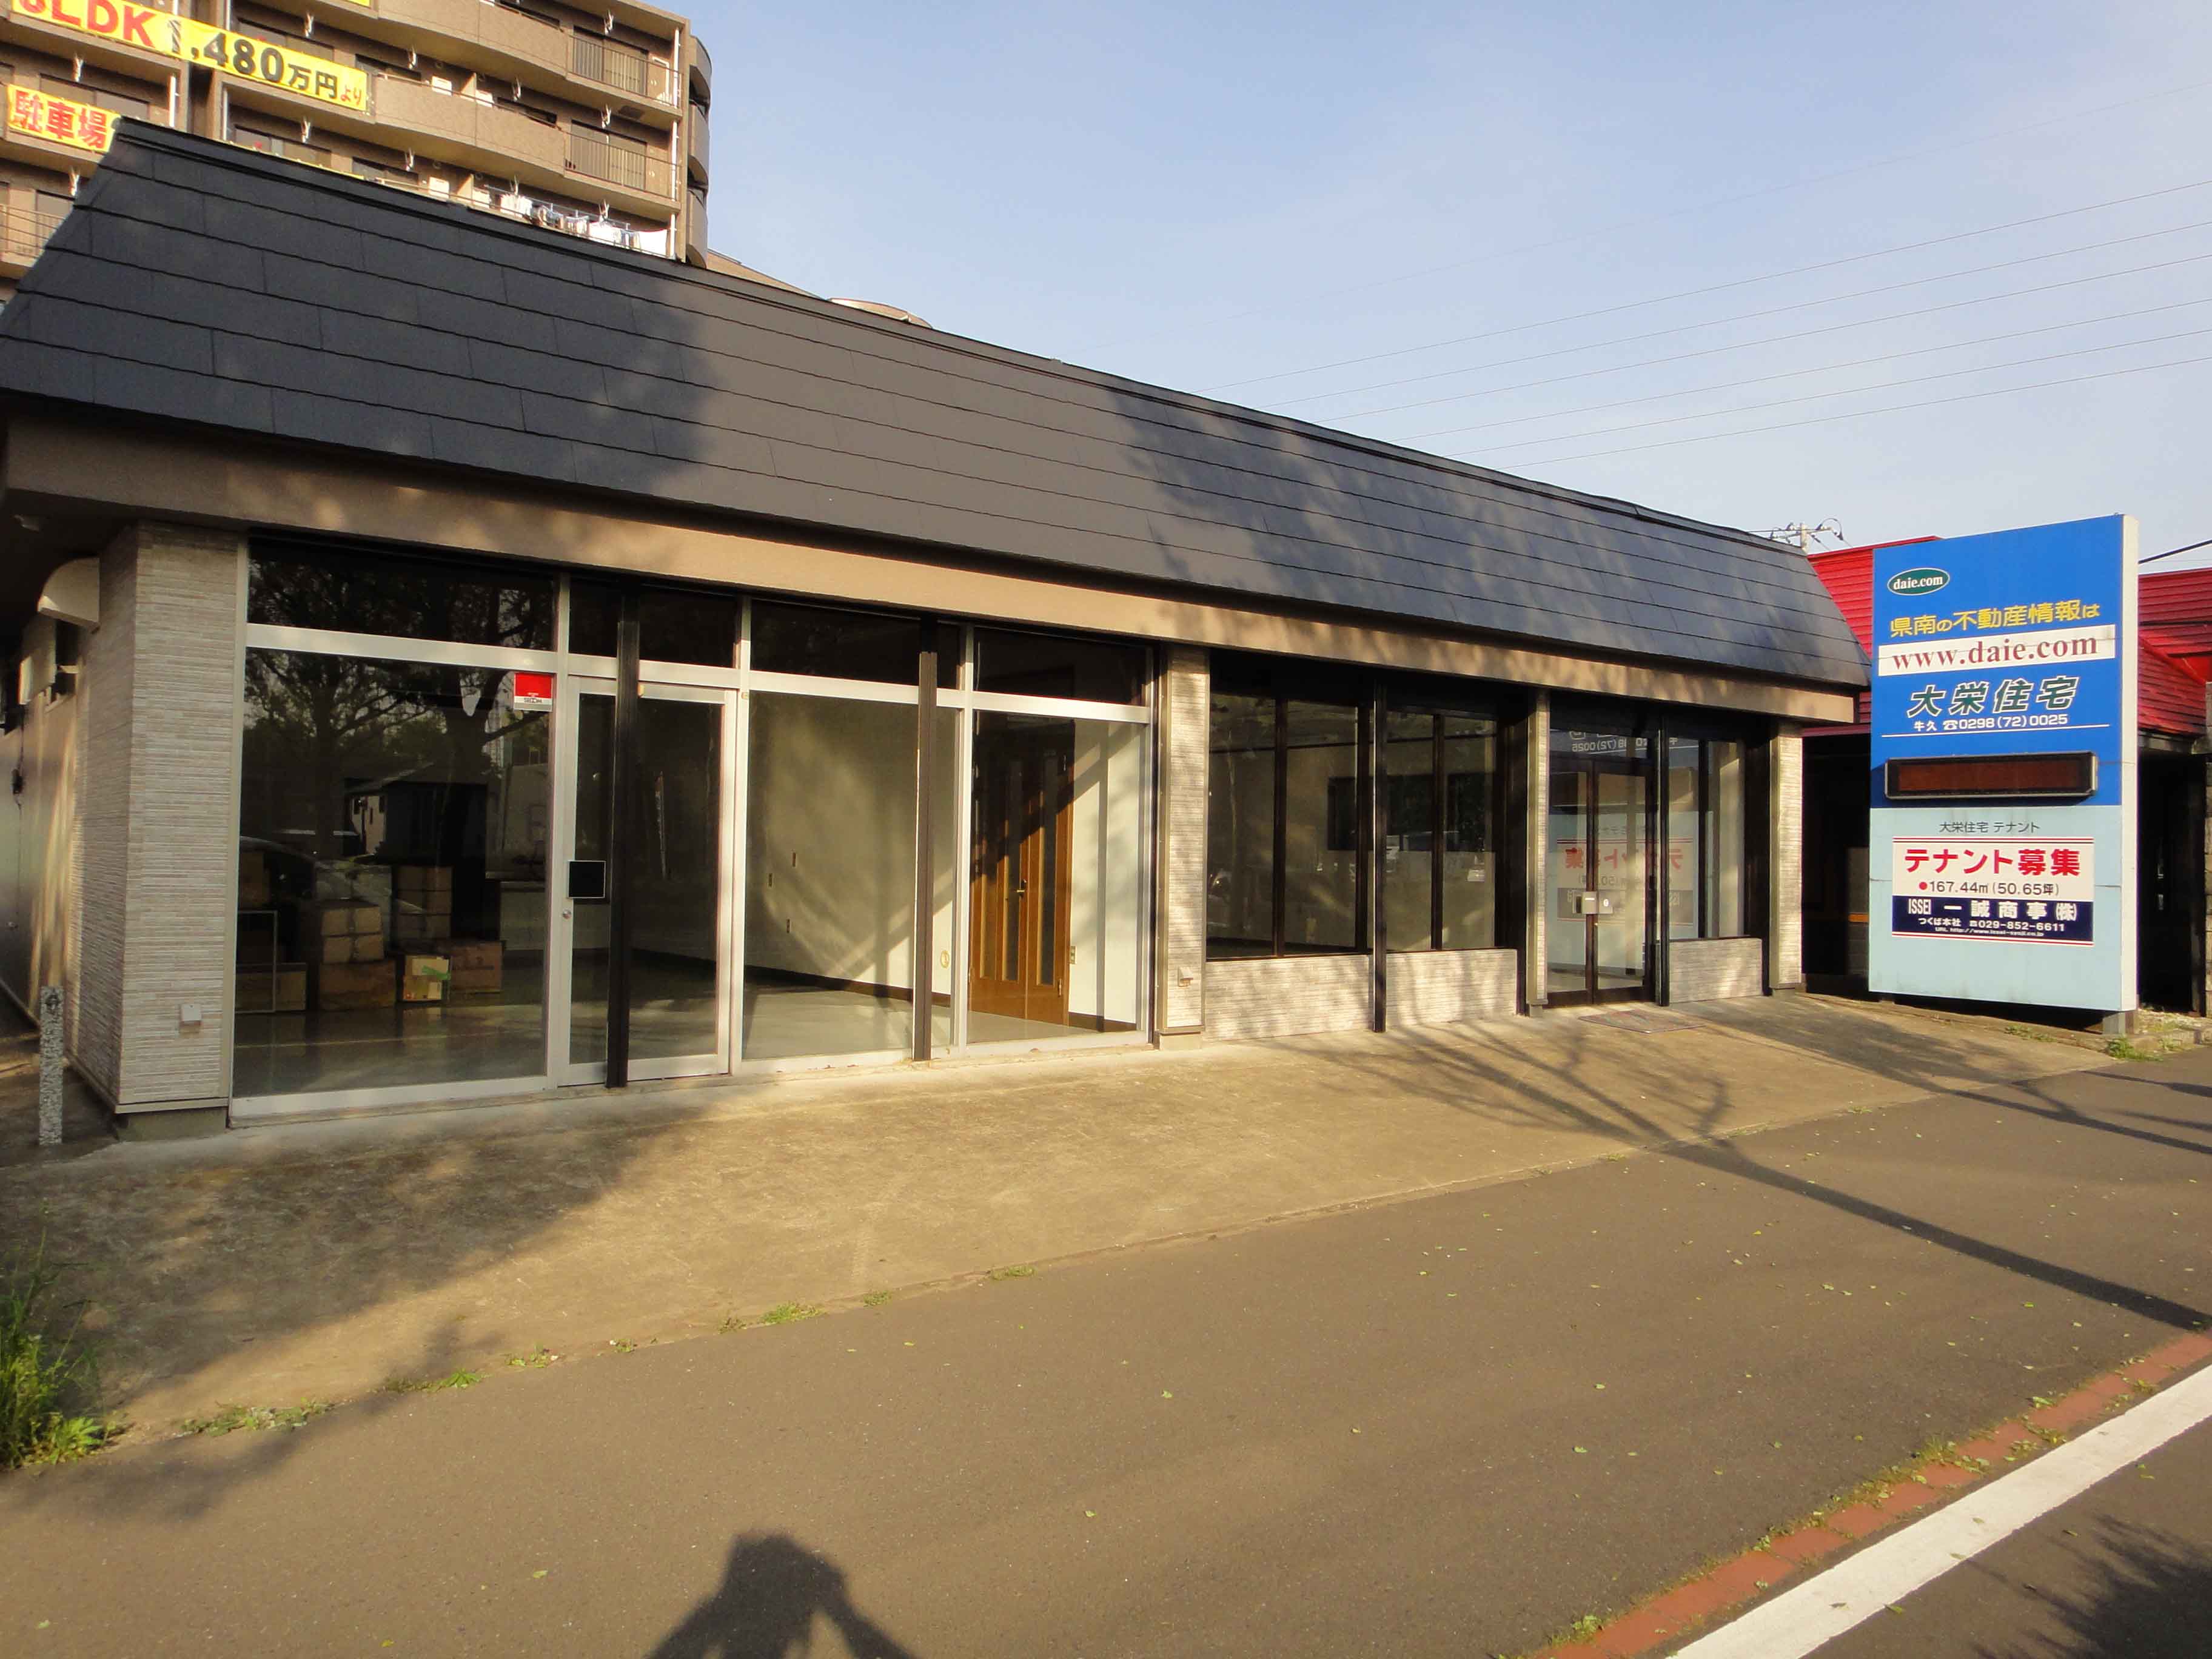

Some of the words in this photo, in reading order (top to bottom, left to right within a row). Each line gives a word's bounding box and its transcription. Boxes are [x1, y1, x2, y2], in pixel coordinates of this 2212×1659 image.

[14, 90, 107, 149] 駐車場
[1892, 575, 1943, 591] daie.com
[1889, 598, 2100, 638] 県南の不動産情報は
[1892, 637, 2097, 671] www.daie.com
[1906, 675, 2080, 719] 大栄住宅
[1914, 720, 1937, 732] 牛久
[1939, 822, 1989, 833] 大栄住宅
[1993, 822, 2040, 834] テナント
[1904, 848, 2080, 877] テナント募集
[1908, 898, 1932, 915] ISSEI
[1917, 917, 1962, 927] つくば本社
[1977, 919, 2065, 932] 029-852-6611
